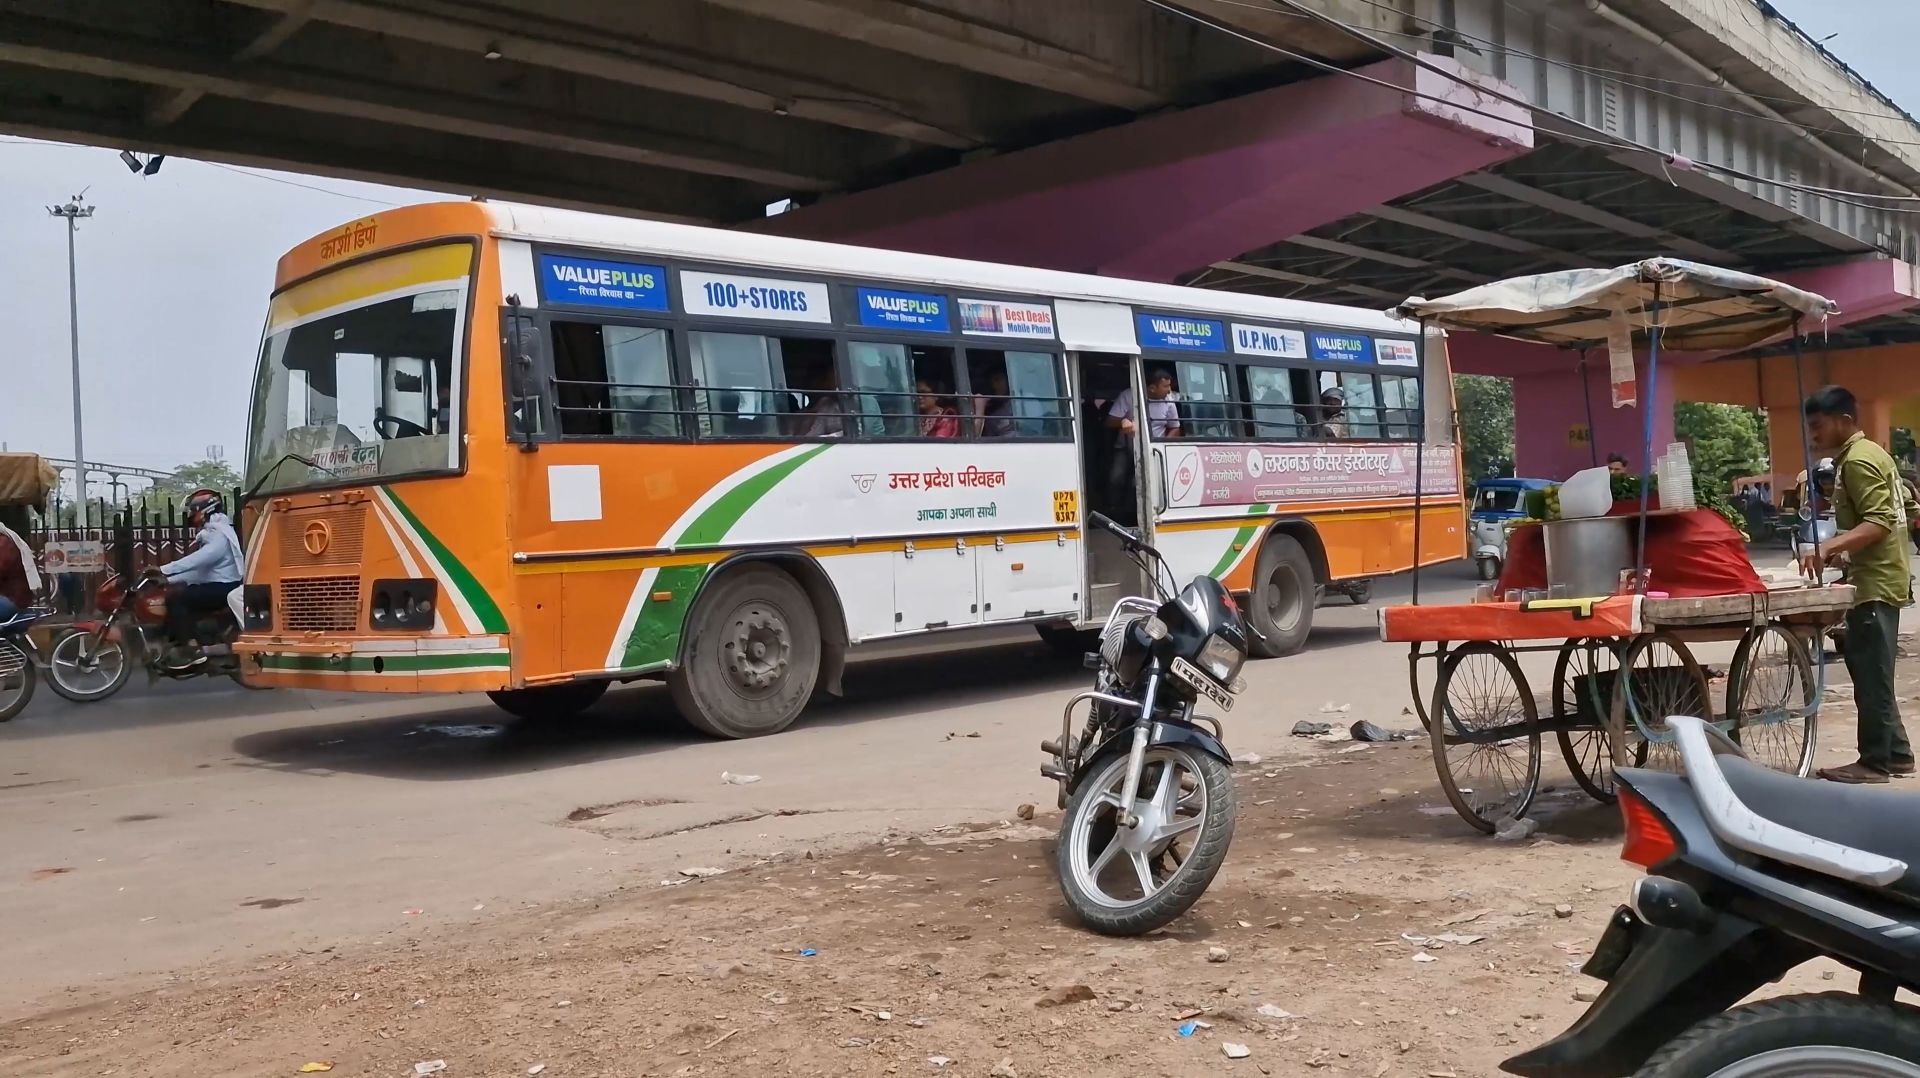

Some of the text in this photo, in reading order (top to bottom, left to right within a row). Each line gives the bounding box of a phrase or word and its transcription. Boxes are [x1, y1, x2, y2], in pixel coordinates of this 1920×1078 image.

[320, 217, 378, 260] काशी डिपो
[552, 264, 656, 289] VALUEPLUS
[867, 295, 940, 315] VALUEPLUS
[1005, 308, 1051, 324] Best Deals
[1151, 318, 1212, 337] VALUEPLUS
[1315, 336, 1362, 351] VALUEPLUS
[1263, 454, 1310, 473] लखनऊ
[889, 465, 1006, 491] उत्तर प्रदेश परिवहन
[917, 501, 997, 521] आपका अपना साथी
